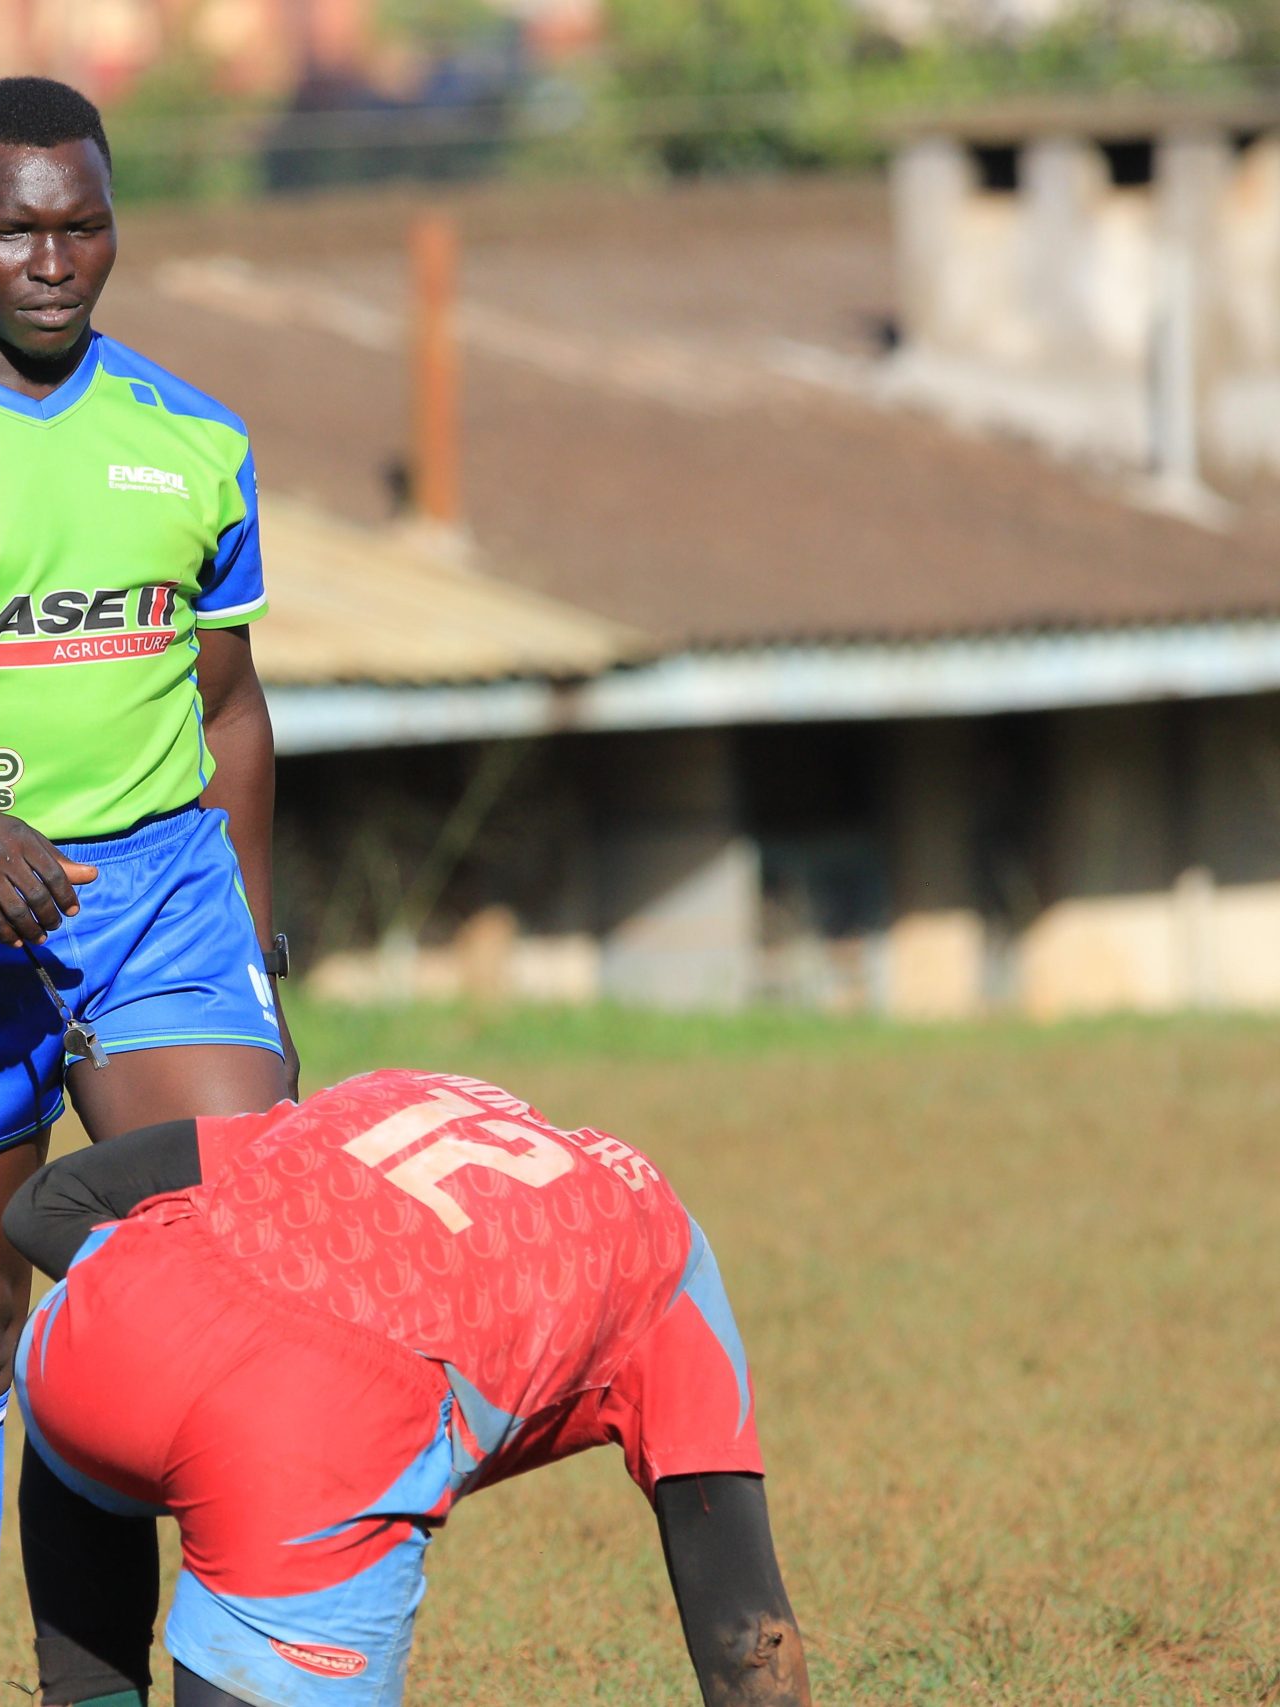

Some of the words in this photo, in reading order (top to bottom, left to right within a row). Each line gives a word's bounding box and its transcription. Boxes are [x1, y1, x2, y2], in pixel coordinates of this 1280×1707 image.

[53, 635, 170, 660] AGRICULTURE
[341, 1087, 575, 1235] 12
[412, 1073, 661, 1193] MONERS
